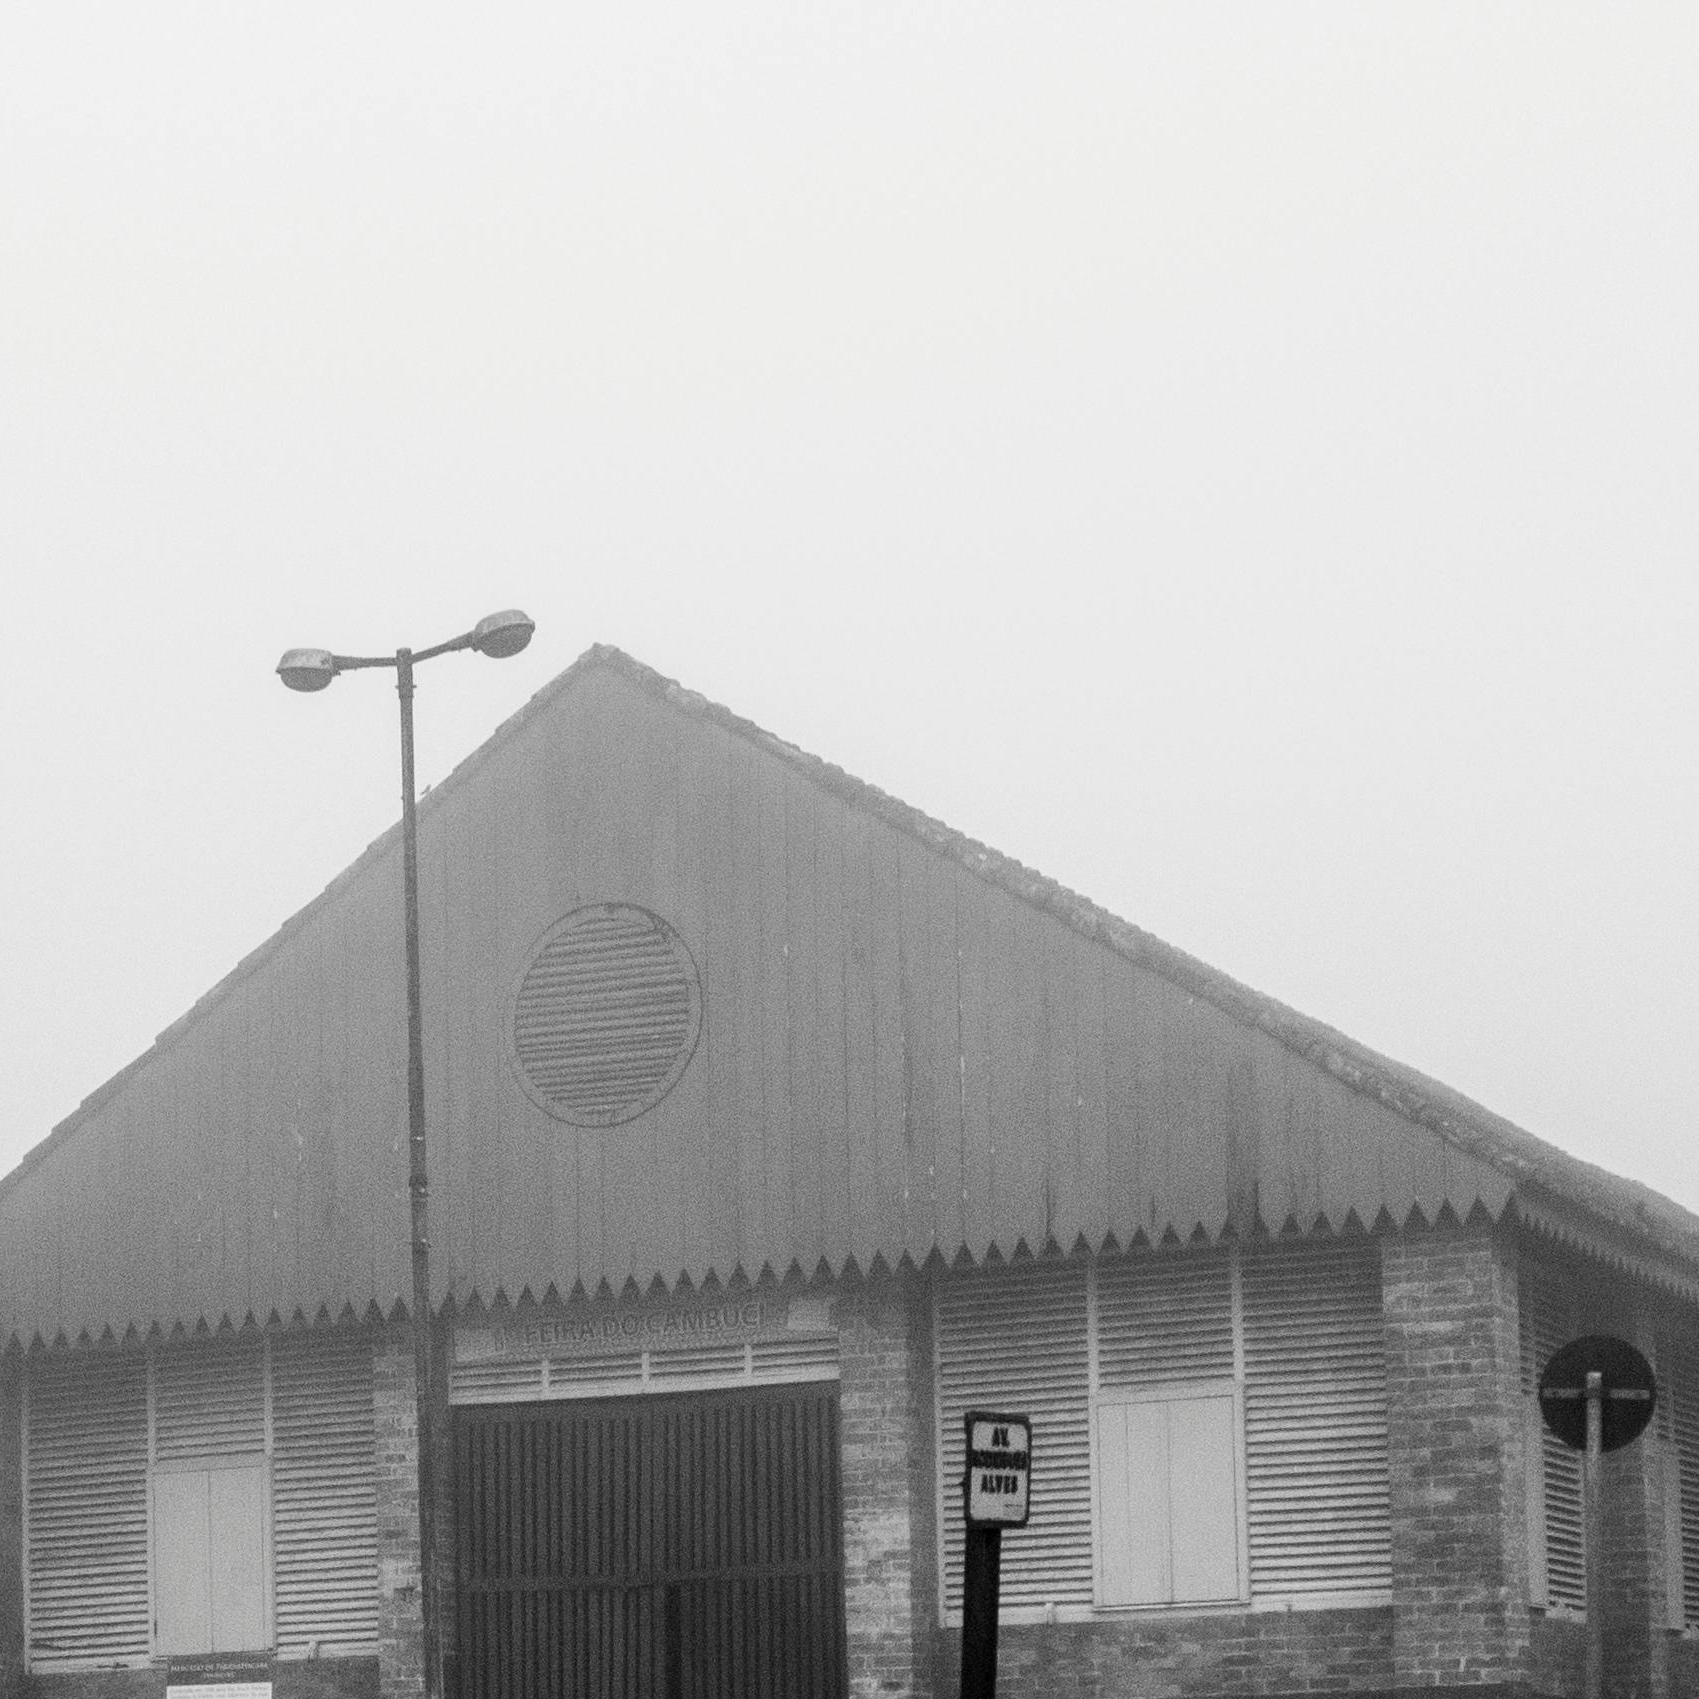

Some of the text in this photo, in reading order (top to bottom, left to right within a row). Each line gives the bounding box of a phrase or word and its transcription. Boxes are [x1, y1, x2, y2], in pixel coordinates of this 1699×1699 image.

[525, 1317, 593, 1344] FEIRA
[602, 1311, 639, 1335] DO
[645, 1303, 765, 1333] CAMBUCI
